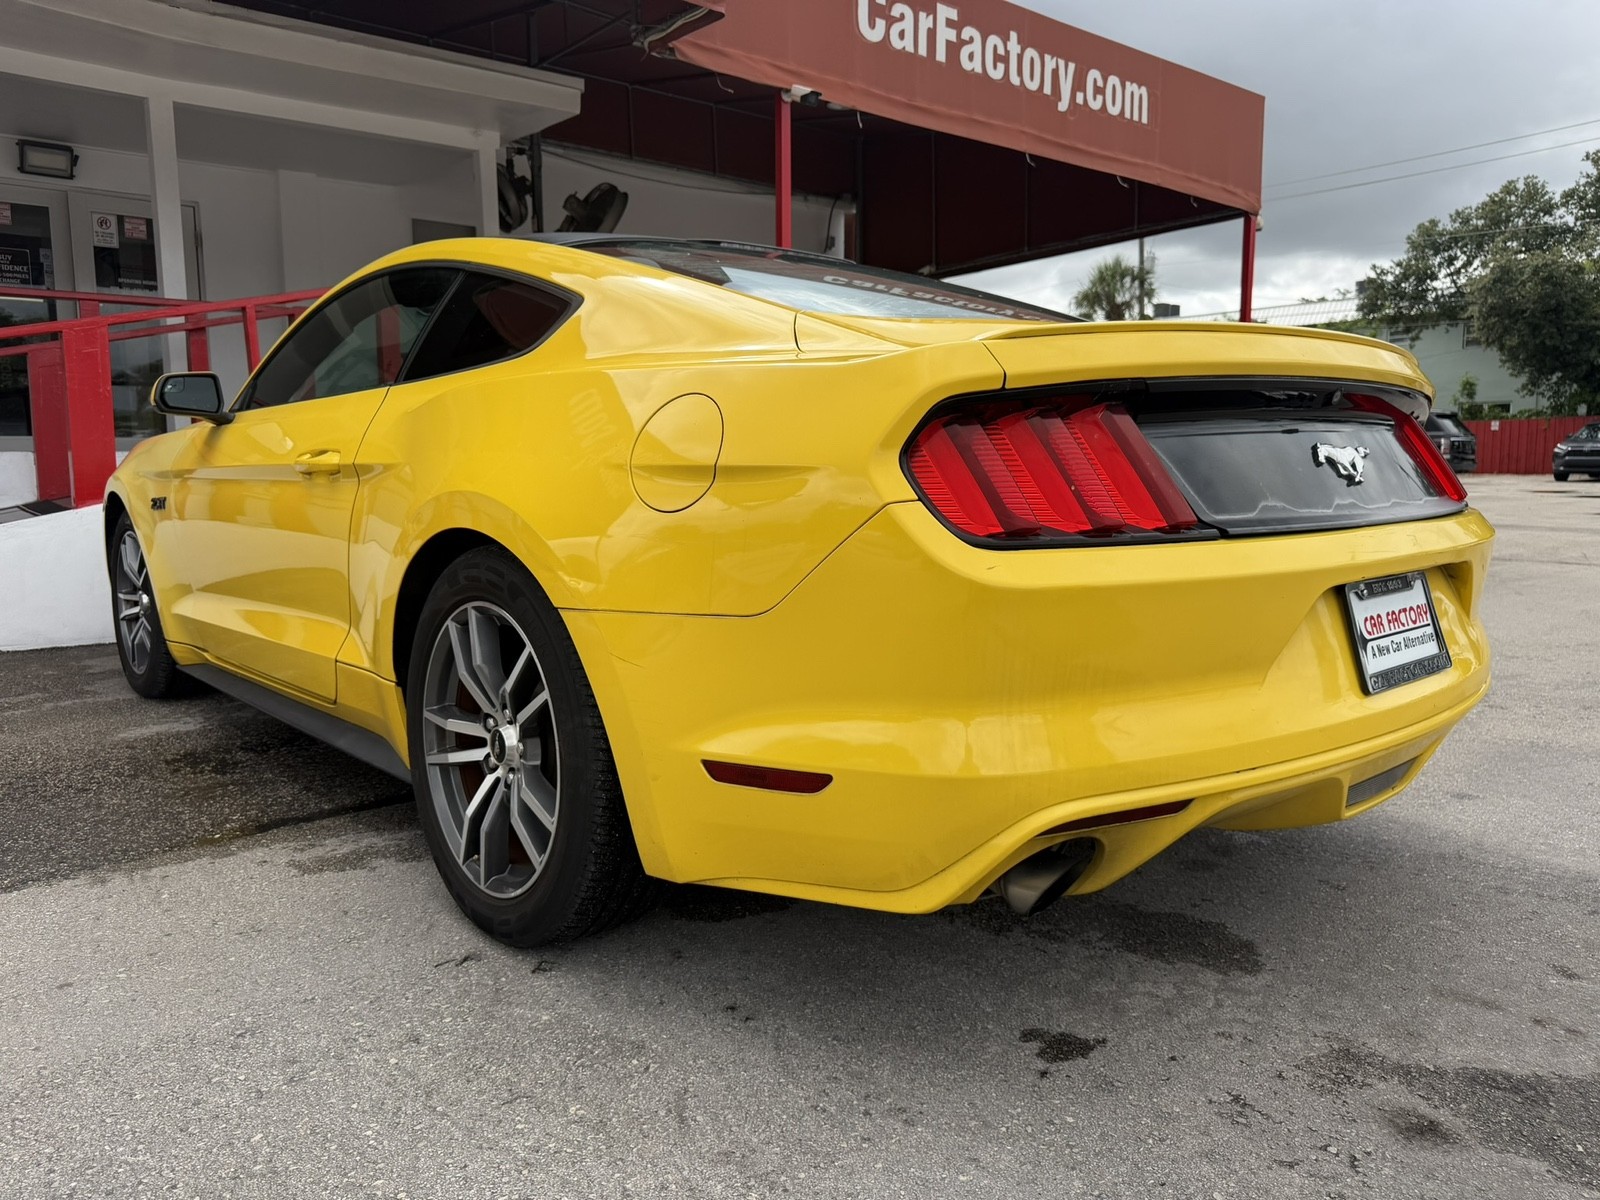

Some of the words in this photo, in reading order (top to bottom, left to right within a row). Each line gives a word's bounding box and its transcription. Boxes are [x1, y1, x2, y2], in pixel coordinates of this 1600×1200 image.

[857, 0, 1149, 125] CarFactory.com
[1363, 613, 1386, 636] CAR
[1386, 603, 1429, 631] FACTORY
[1371, 645, 1378, 659] A
[1376, 644, 1391, 658] New
[1390, 640, 1403, 653] Car
[1403, 631, 1435, 650] Alternative
